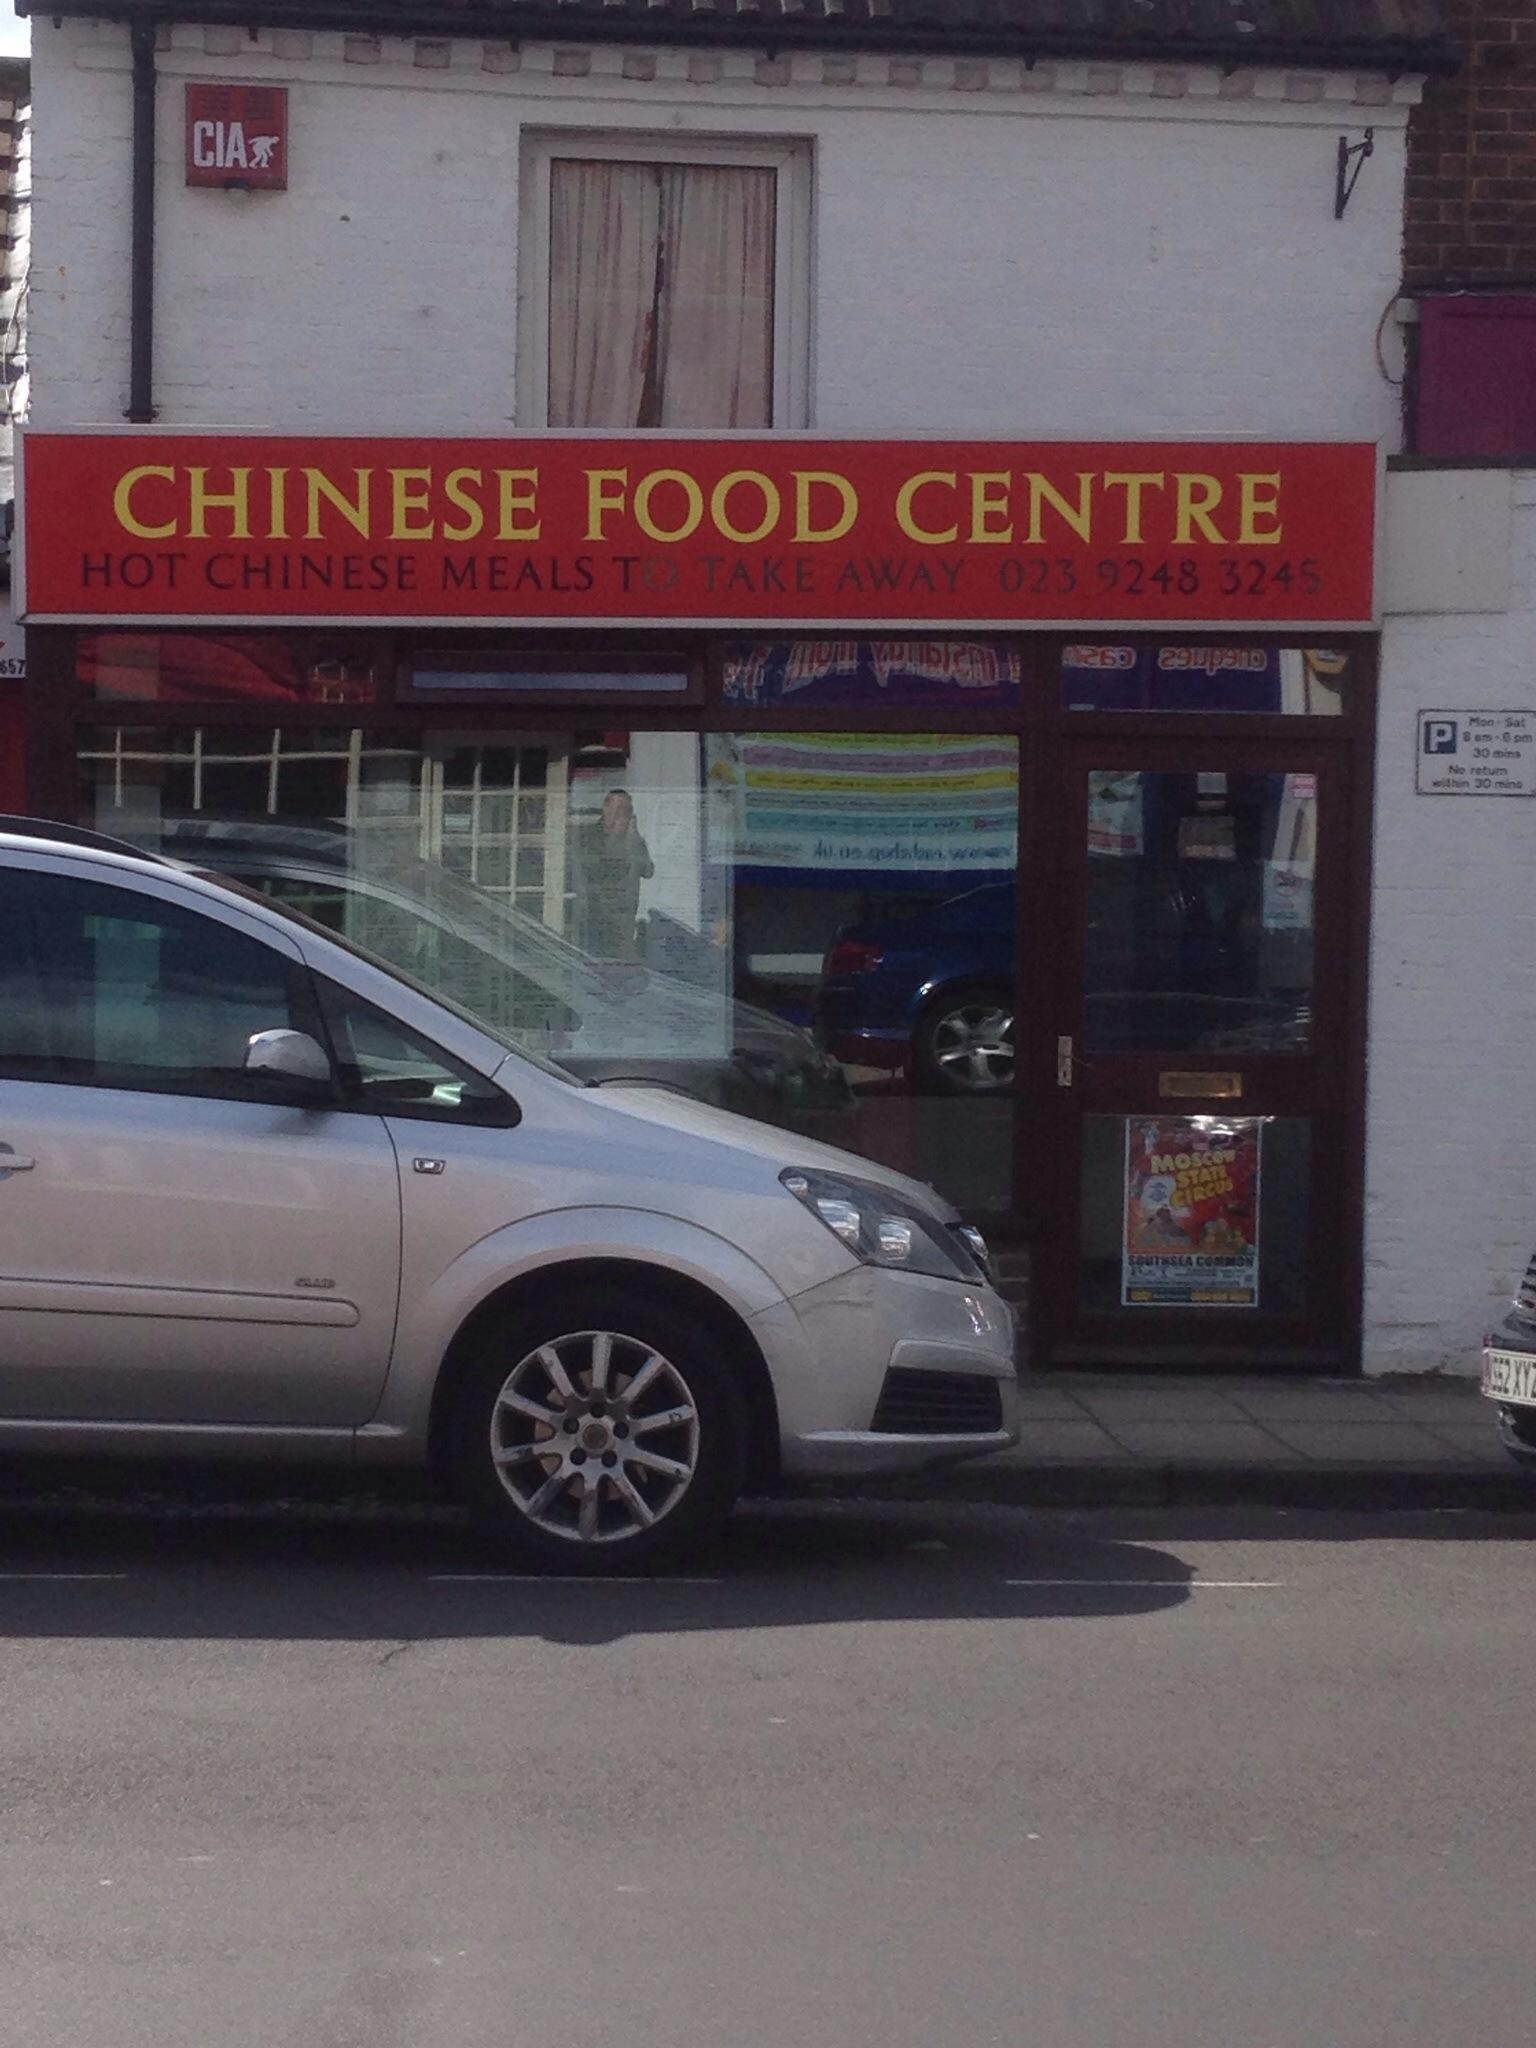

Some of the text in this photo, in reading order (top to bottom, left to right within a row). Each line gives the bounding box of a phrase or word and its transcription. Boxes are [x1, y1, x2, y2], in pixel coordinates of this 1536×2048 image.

[194, 120, 247, 168] CIA
[113, 465, 1283, 546] CHINESE FOOD CENTRE
[81, 552, 1322, 596] HOT CHINESE MEALS TO TAKE AWAY 023 9248 3245
[1469, 717, 1494, 727] Mon
[1505, 717, 1526, 728] Sat
[1429, 723, 1453, 752] P
[1473, 749, 1521, 759] 30 mins
[1449, 765, 1508, 776] No return
[1475, 779, 1491, 788] 30
[1150, 1149, 1236, 1174] MOSCOW
[1171, 1176, 1234, 1207] CIRCUS
